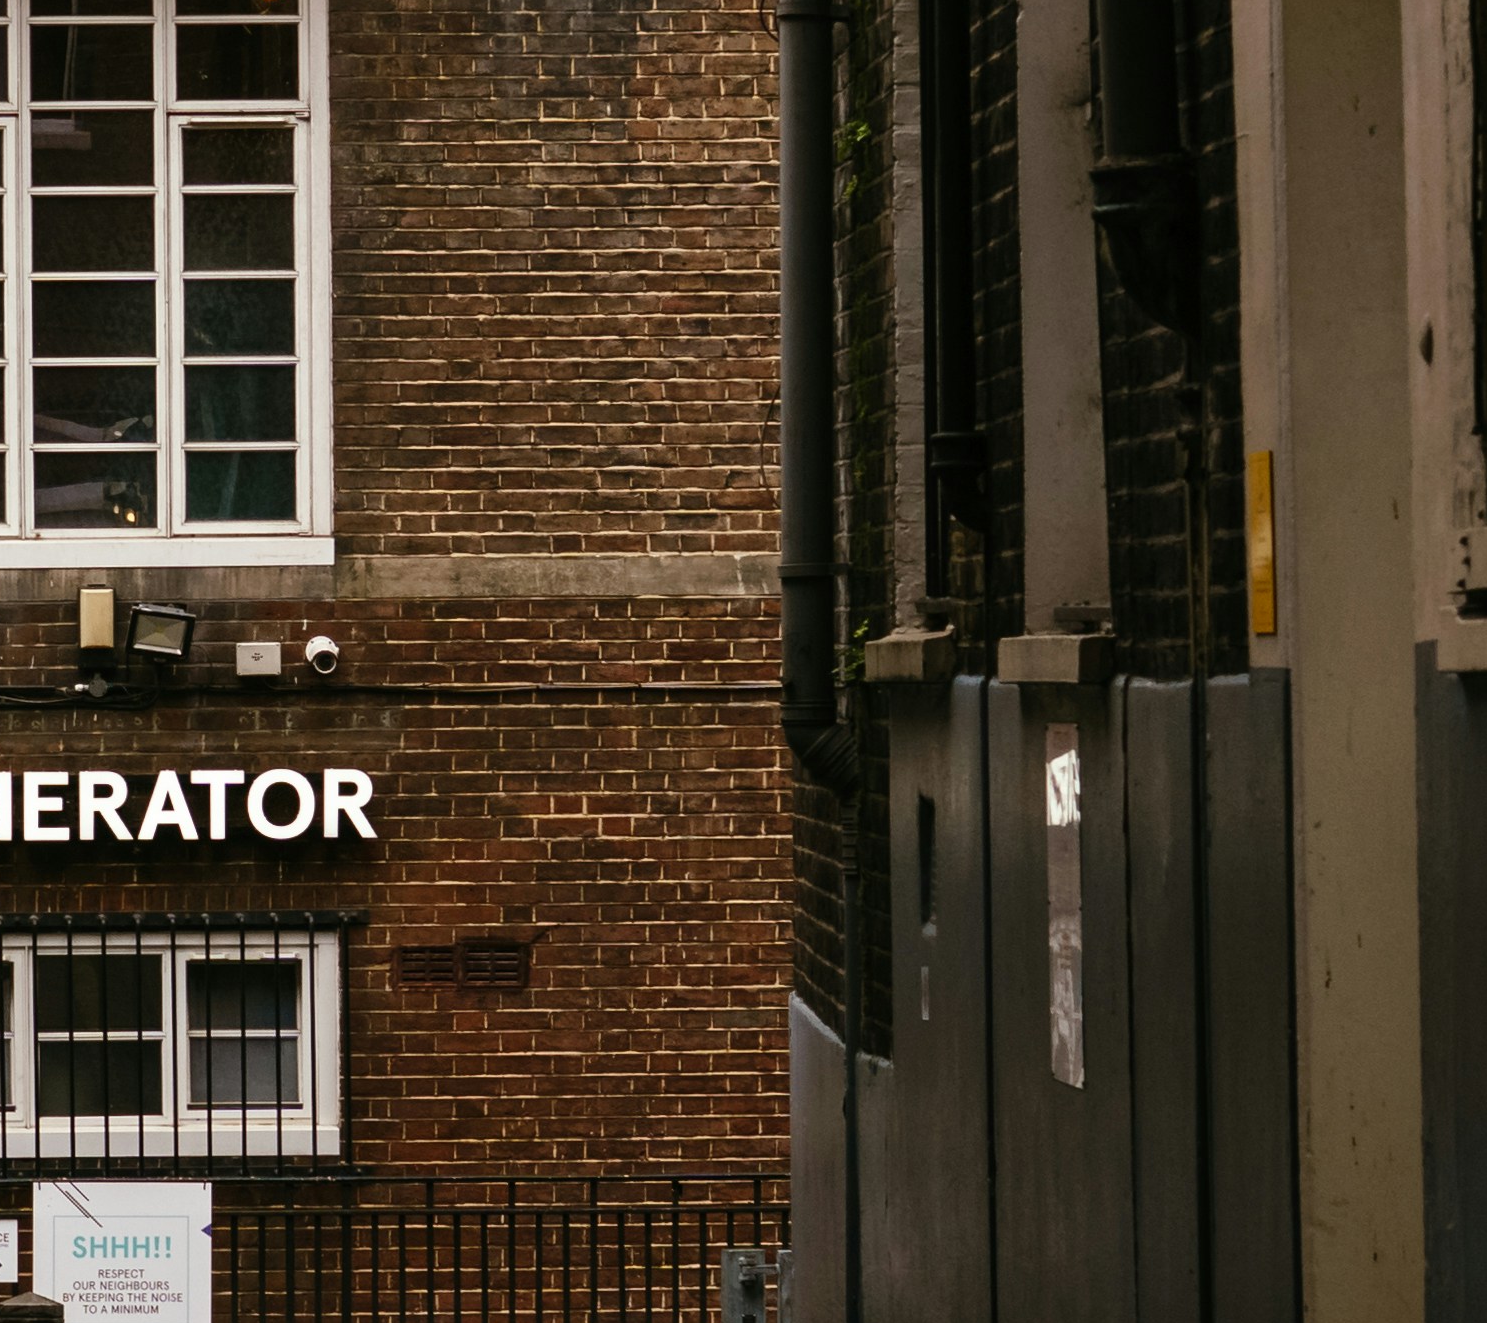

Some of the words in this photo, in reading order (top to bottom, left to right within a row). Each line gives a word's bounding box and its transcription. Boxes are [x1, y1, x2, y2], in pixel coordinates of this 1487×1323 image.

[72, 1236, 172, 1259] SHHH!!
[98, 1269, 145, 1279] RESPECT
[72, 1281, 96, 1291] OUR
[100, 1281, 170, 1291] NEIGHBOURS
[62, 1293, 75, 1303] BY
[79, 1293, 124, 1303] KEEPING
[128, 1293, 149, 1303] THE
[151, 1293, 183, 1303] NOISE
[83, 1305, 97, 1314] TO
[100, 1305, 108, 1314] A
[111, 1305, 159, 1314] MINIMUM
